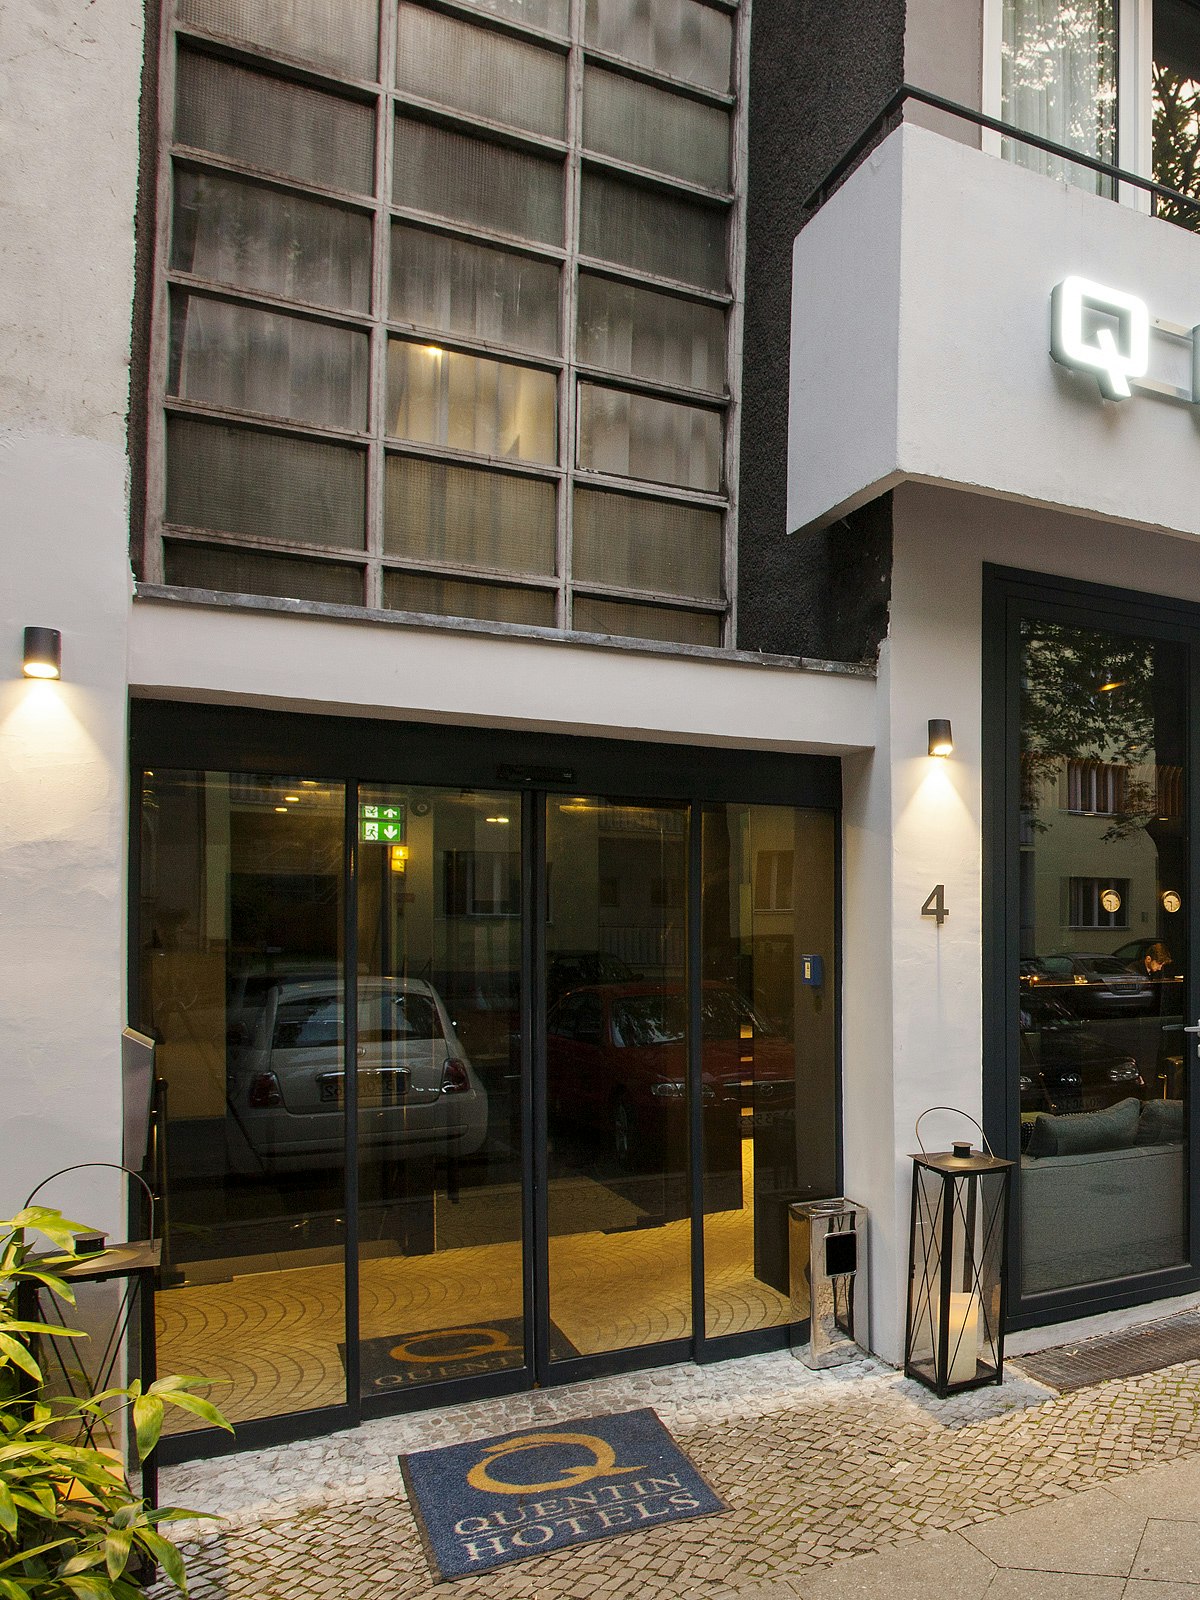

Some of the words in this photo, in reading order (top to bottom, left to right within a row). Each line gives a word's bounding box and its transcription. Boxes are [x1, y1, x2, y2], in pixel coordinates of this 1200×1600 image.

[1051, 275, 1149, 401] Q
[921, 884, 949, 924] 4
[374, 1348, 559, 1387] QUENT
[389, 1328, 524, 1363] Q
[467, 1433, 648, 1495] Q
[454, 1473, 682, 1535] QUENTIN
[465, 1492, 701, 1563] HOTELS
